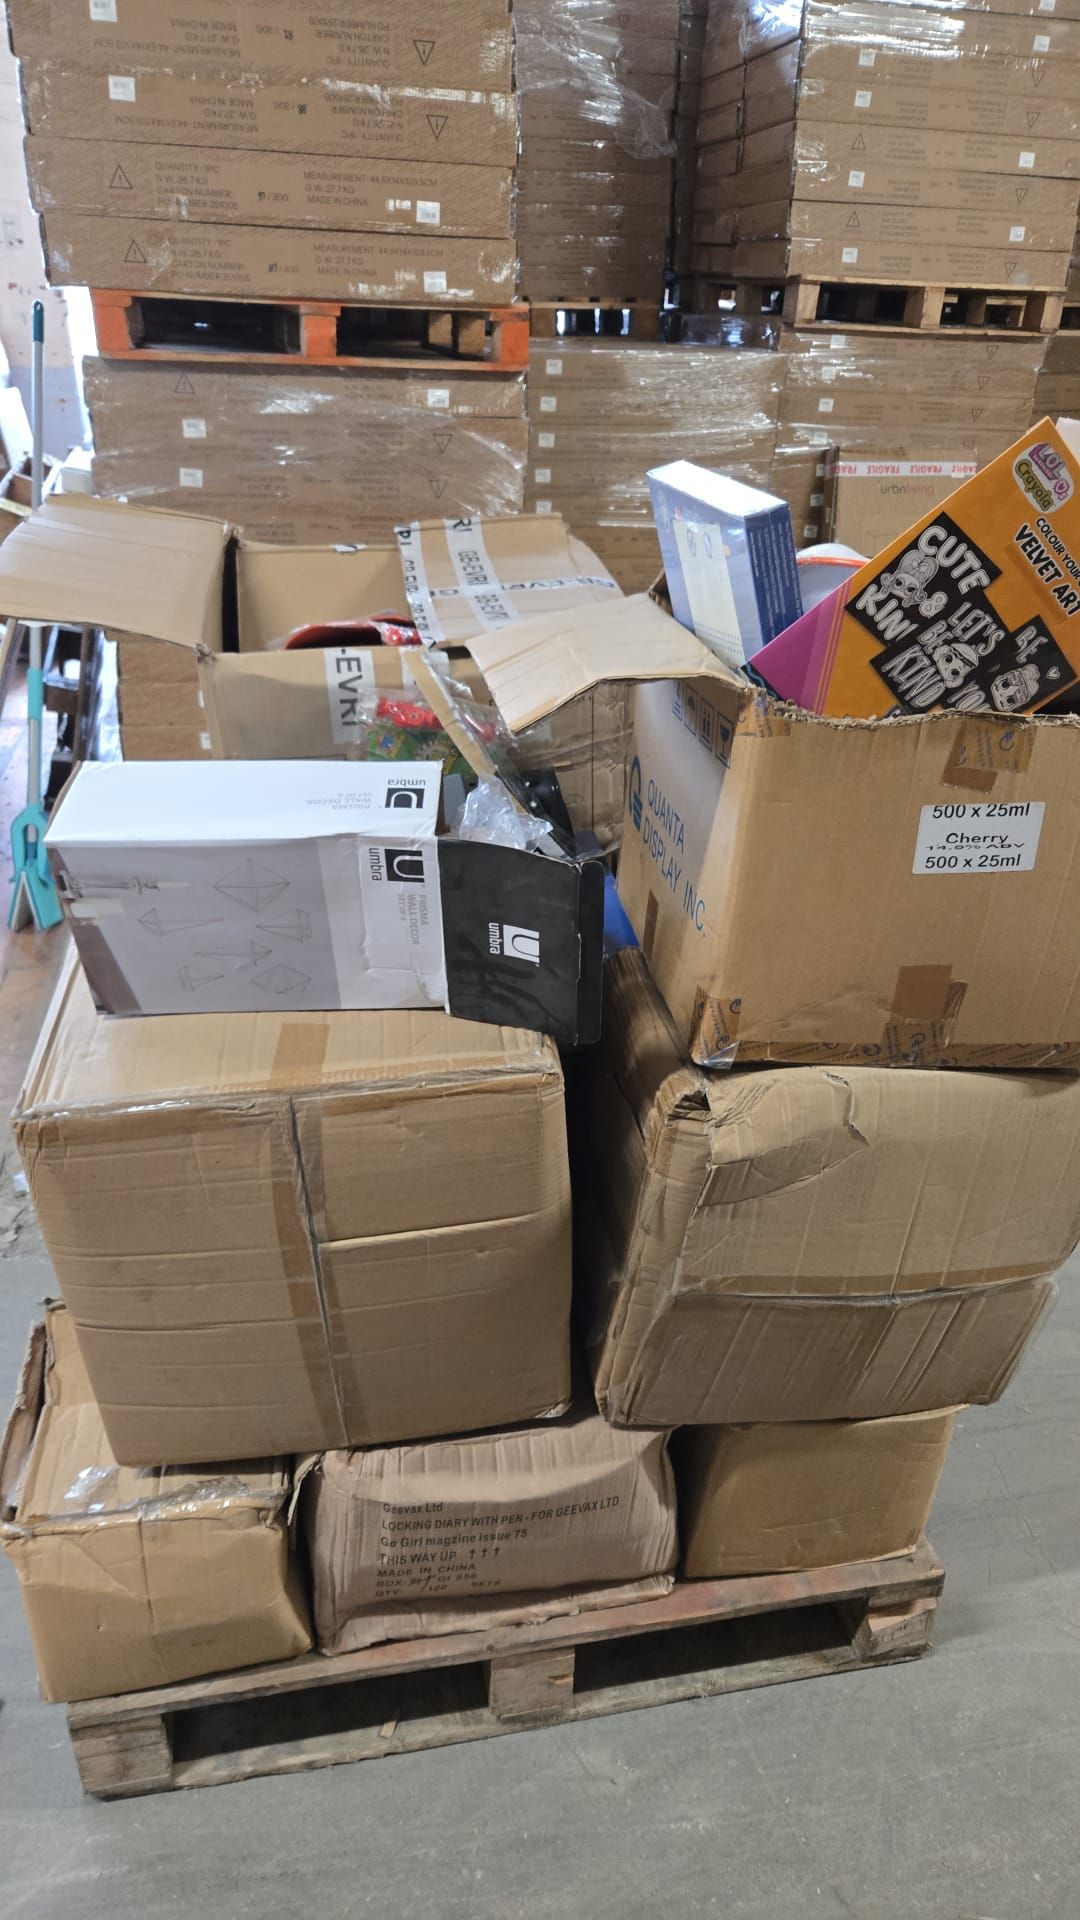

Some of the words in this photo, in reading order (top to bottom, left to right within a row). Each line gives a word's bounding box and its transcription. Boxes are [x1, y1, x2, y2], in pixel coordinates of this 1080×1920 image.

[1016, 460, 1054, 511] Crayola
[1036, 518, 1065, 555] COLOUR
[917, 525, 991, 596] CUTE
[1015, 524, 1063, 583] VELVET
[1052, 584, 1080, 616] ART
[387, 778, 426, 787] umbra
[647, 779, 685, 854] QUANTA
[932, 804, 966, 819] 500
[970, 806, 981, 818] x
[986, 803, 1031, 818] 25ml
[945, 832, 1010, 845] Cherry
[368, 847, 384, 881] umbra
[925, 856, 958, 869] 500
[963, 857, 973, 868] x
[978, 854, 1022, 868] 25ml
[642, 820, 682, 894] DISPLAY
[683, 880, 707, 938] INC.
[407, 894, 417, 917] WALL
[418, 894, 429, 926] PRISMA
[409, 917, 420, 945] DECOR
[488, 922, 504, 955] umbra
[382, 1519, 432, 1531] LOCKING
[434, 1518, 467, 1529] DIARY
[471, 1515, 499, 1526] WITH
[501, 1514, 523, 1525] PEN
[531, 1509, 554, 1521] FOR
[555, 1501, 598, 1518] GEEVAX
[600, 1495, 620, 1510] LTD
[425, 1502, 443, 1513] Ltd
[381, 1536, 397, 1548] Go
[400, 1537, 422, 1548] Girl
[425, 1534, 476, 1547] magzine
[479, 1530, 511, 1542] issue
[514, 1529, 528, 1539] 75
[378, 1568, 413, 1577] MADE
[438, 1563, 476, 1573] CHINA
[379, 1552, 407, 1566] THIS
[410, 1552, 437, 1564] WAY
[440, 1551, 457, 1561] UP
